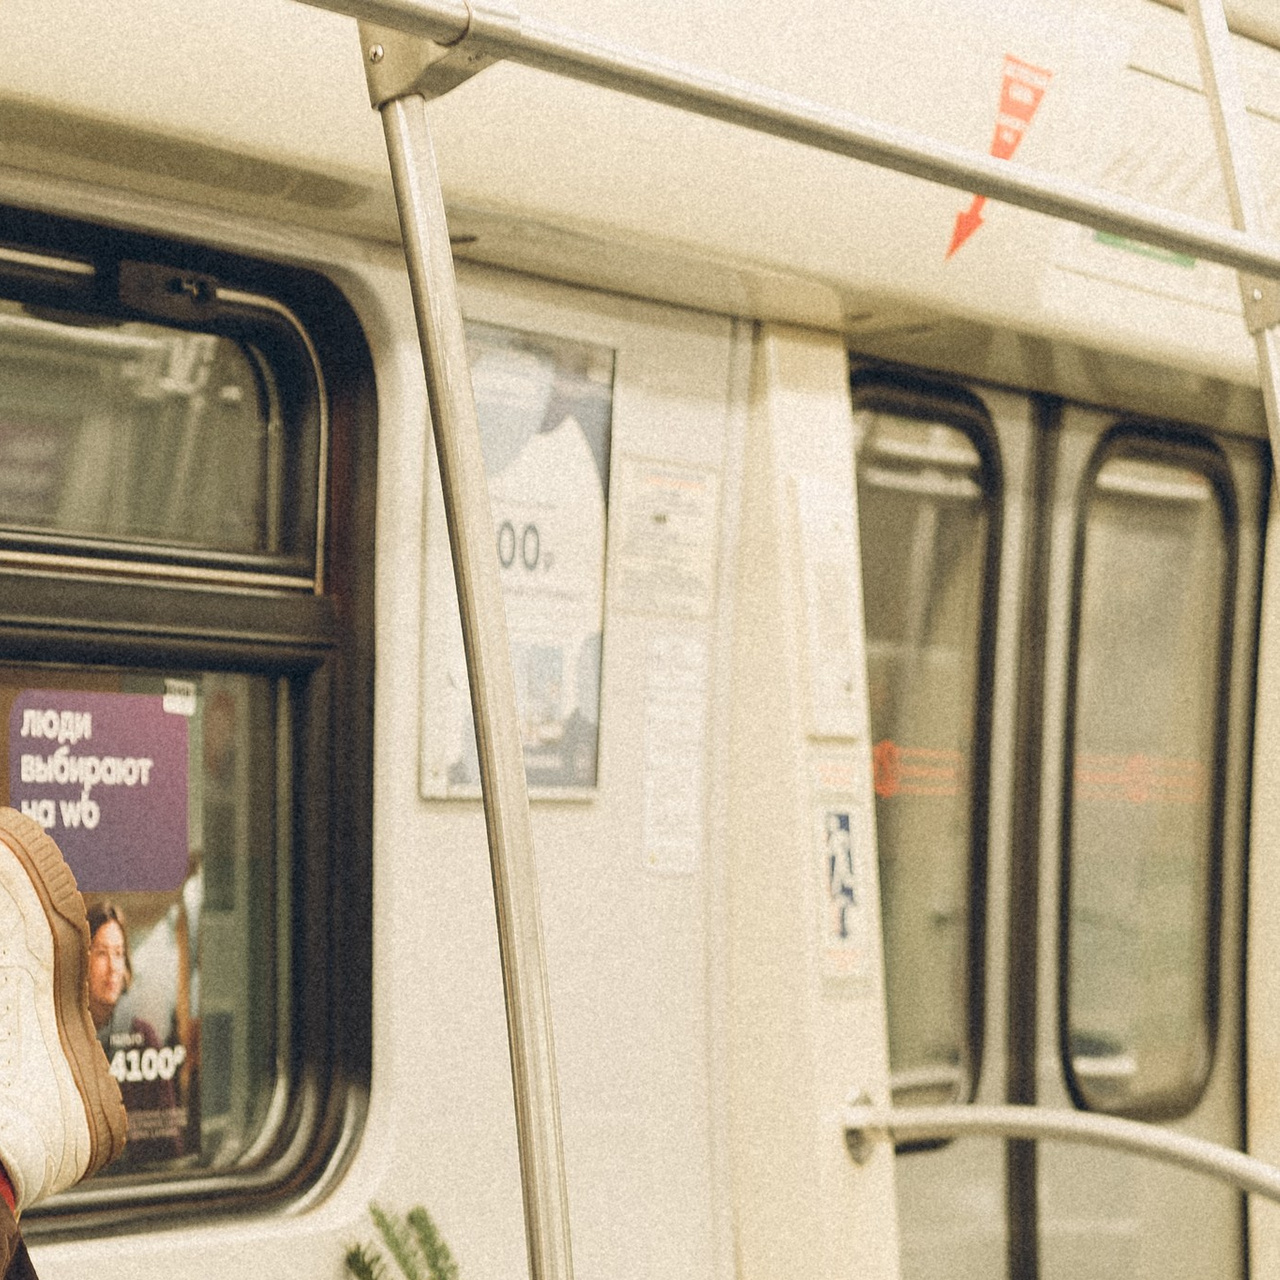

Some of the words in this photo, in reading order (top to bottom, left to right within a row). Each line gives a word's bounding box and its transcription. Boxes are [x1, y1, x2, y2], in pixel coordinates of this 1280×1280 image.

[20, 709, 92, 744] люди
[20, 745, 154, 792] выбирают
[21, 799, 56, 829] на
